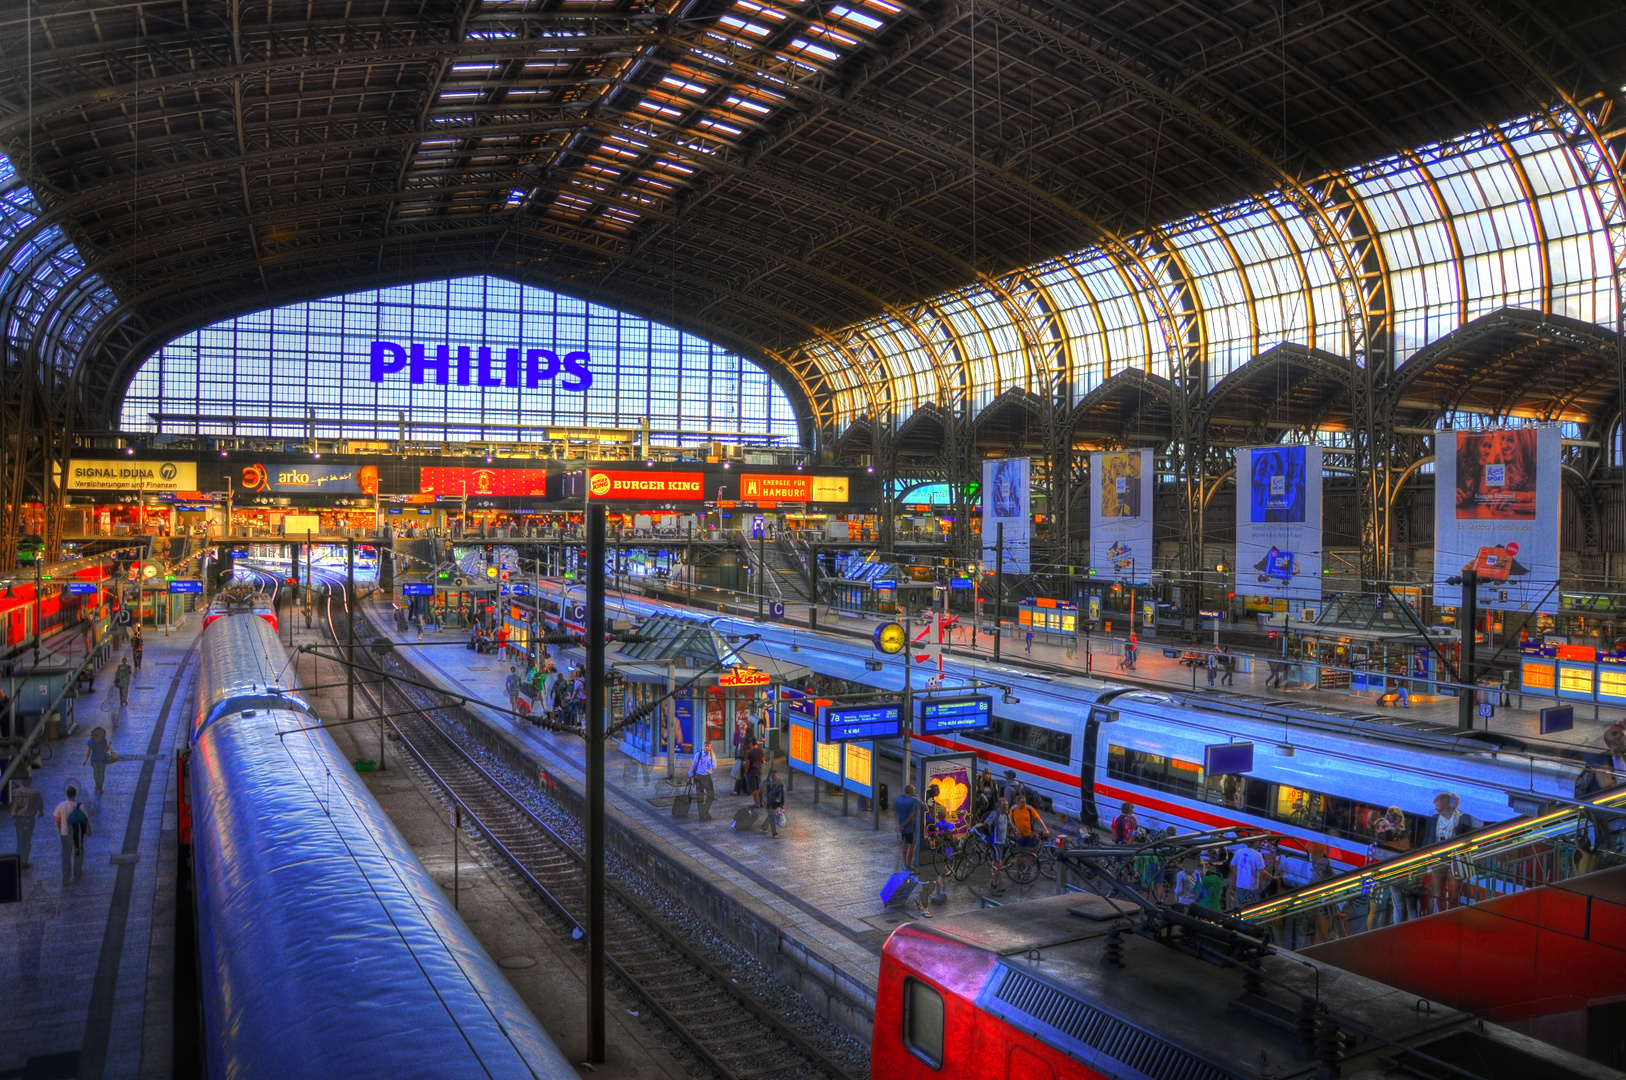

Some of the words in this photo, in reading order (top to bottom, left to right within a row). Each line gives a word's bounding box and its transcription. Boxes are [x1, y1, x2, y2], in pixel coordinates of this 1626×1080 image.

[369, 341, 593, 392] PHILIPS
[75, 467, 118, 478] SIGNAL
[120, 468, 155, 479] IDUNA
[278, 469, 310, 484] arko
[75, 480, 130, 489] Versicherungen
[131, 480, 144, 488] und
[146, 480, 178, 489] Finanzen
[613, 480, 666, 490] BURGER
[667, 481, 700, 491] KING
[763, 488, 805, 497] HAMBURG
[574, 606, 585, 619] C
[774, 602, 783, 615] C
[119, 609, 131, 624] D
[727, 675, 762, 686] KIOSK
[979, 701, 988, 711] 8a
[830, 712, 840, 722] 7a
